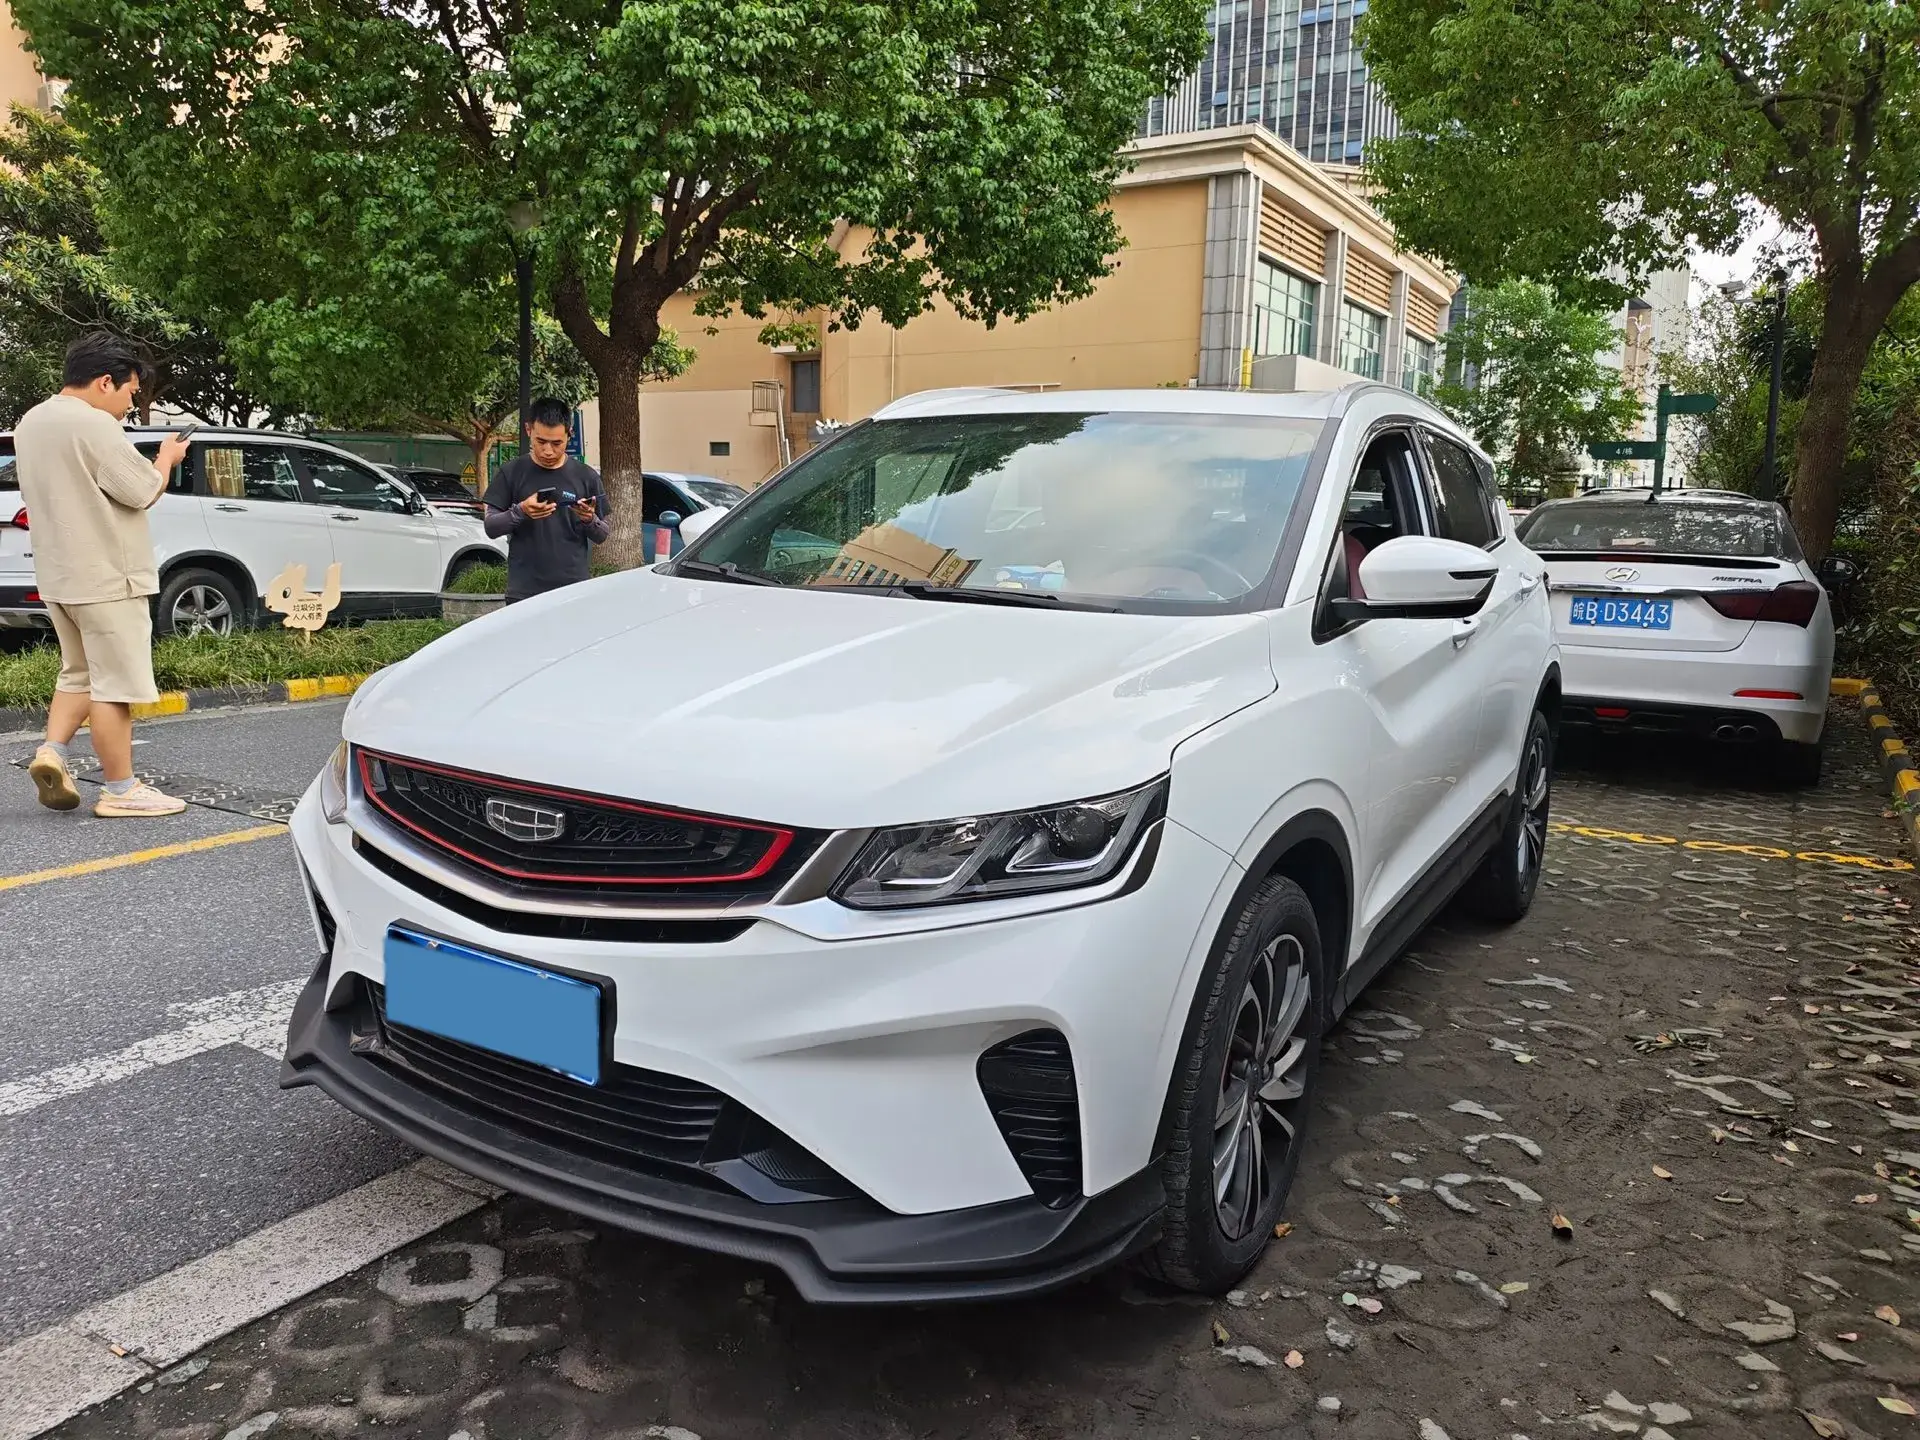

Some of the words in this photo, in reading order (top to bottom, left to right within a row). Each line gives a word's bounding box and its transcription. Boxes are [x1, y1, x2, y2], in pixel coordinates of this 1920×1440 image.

[1711, 576, 1762, 584] MISTRA
[293, 603, 323, 612] 垃圾分类
[293, 612, 323, 621] 人人有责
[1105, 799, 1126, 812] GEELY
